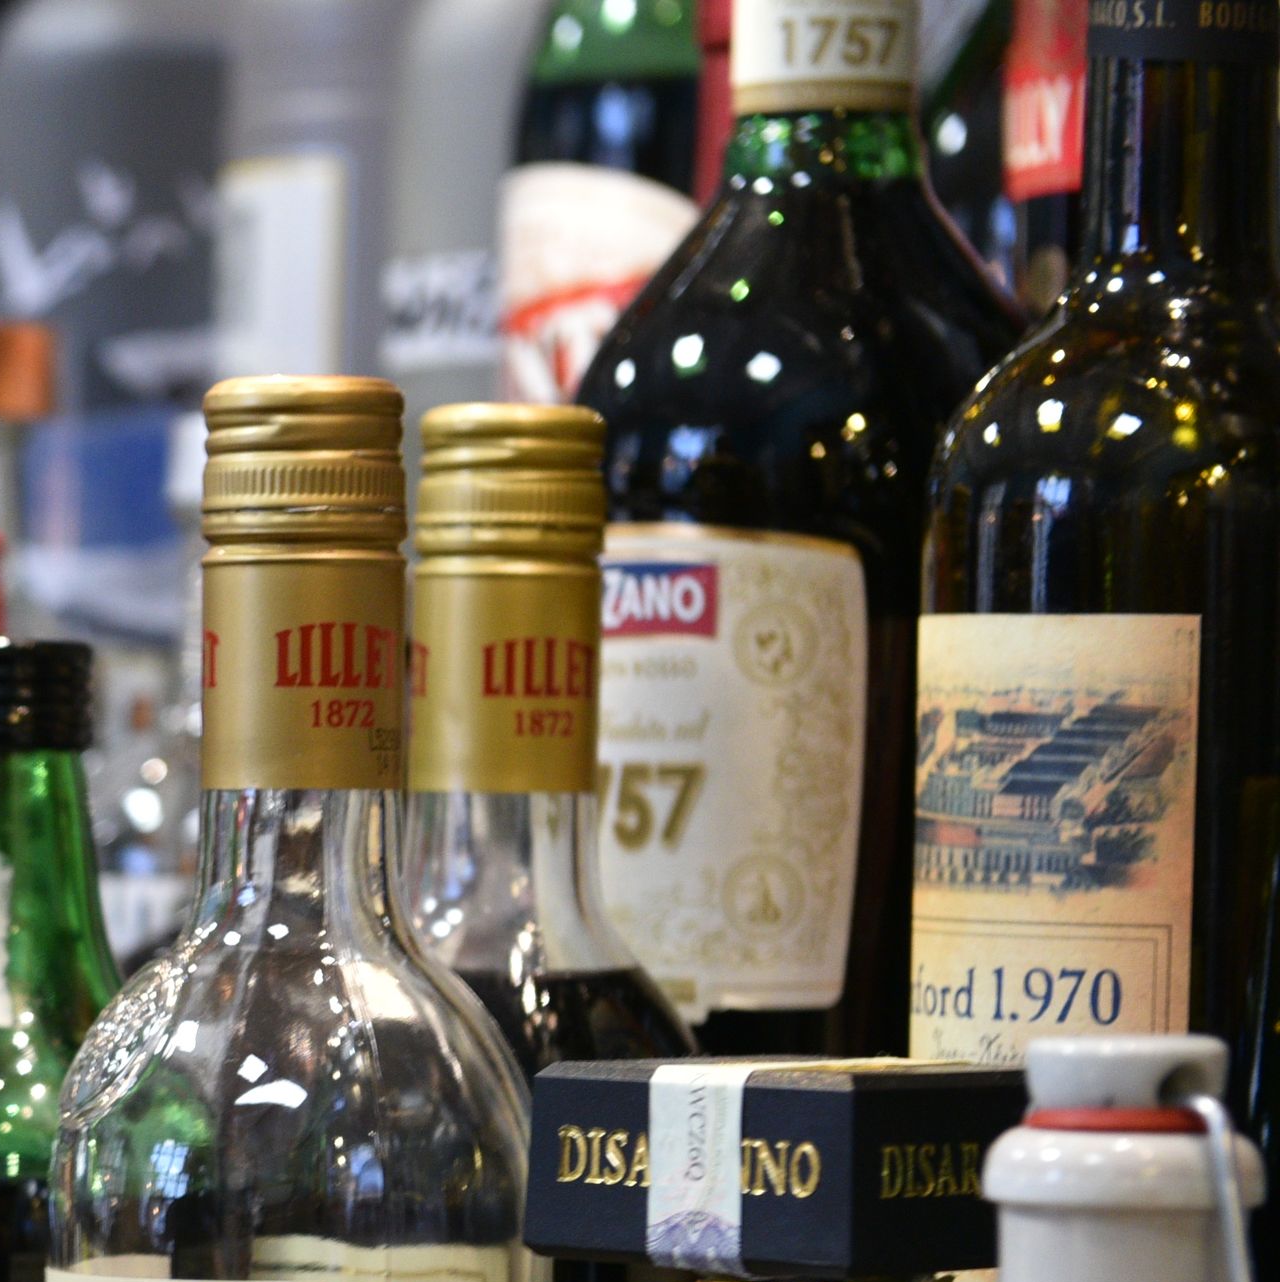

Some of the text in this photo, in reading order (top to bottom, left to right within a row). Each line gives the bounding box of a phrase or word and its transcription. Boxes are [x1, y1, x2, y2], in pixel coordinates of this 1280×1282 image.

[780, 15, 902, 67] 1757
[274, 622, 397, 689] LILLET
[482, 637, 595, 697] LILLET
[310, 700, 375, 729] 1872
[515, 711, 575, 738] 1872
[992, 966, 1122, 1026] 1.970
[556, 1125, 821, 1198] DISANO
